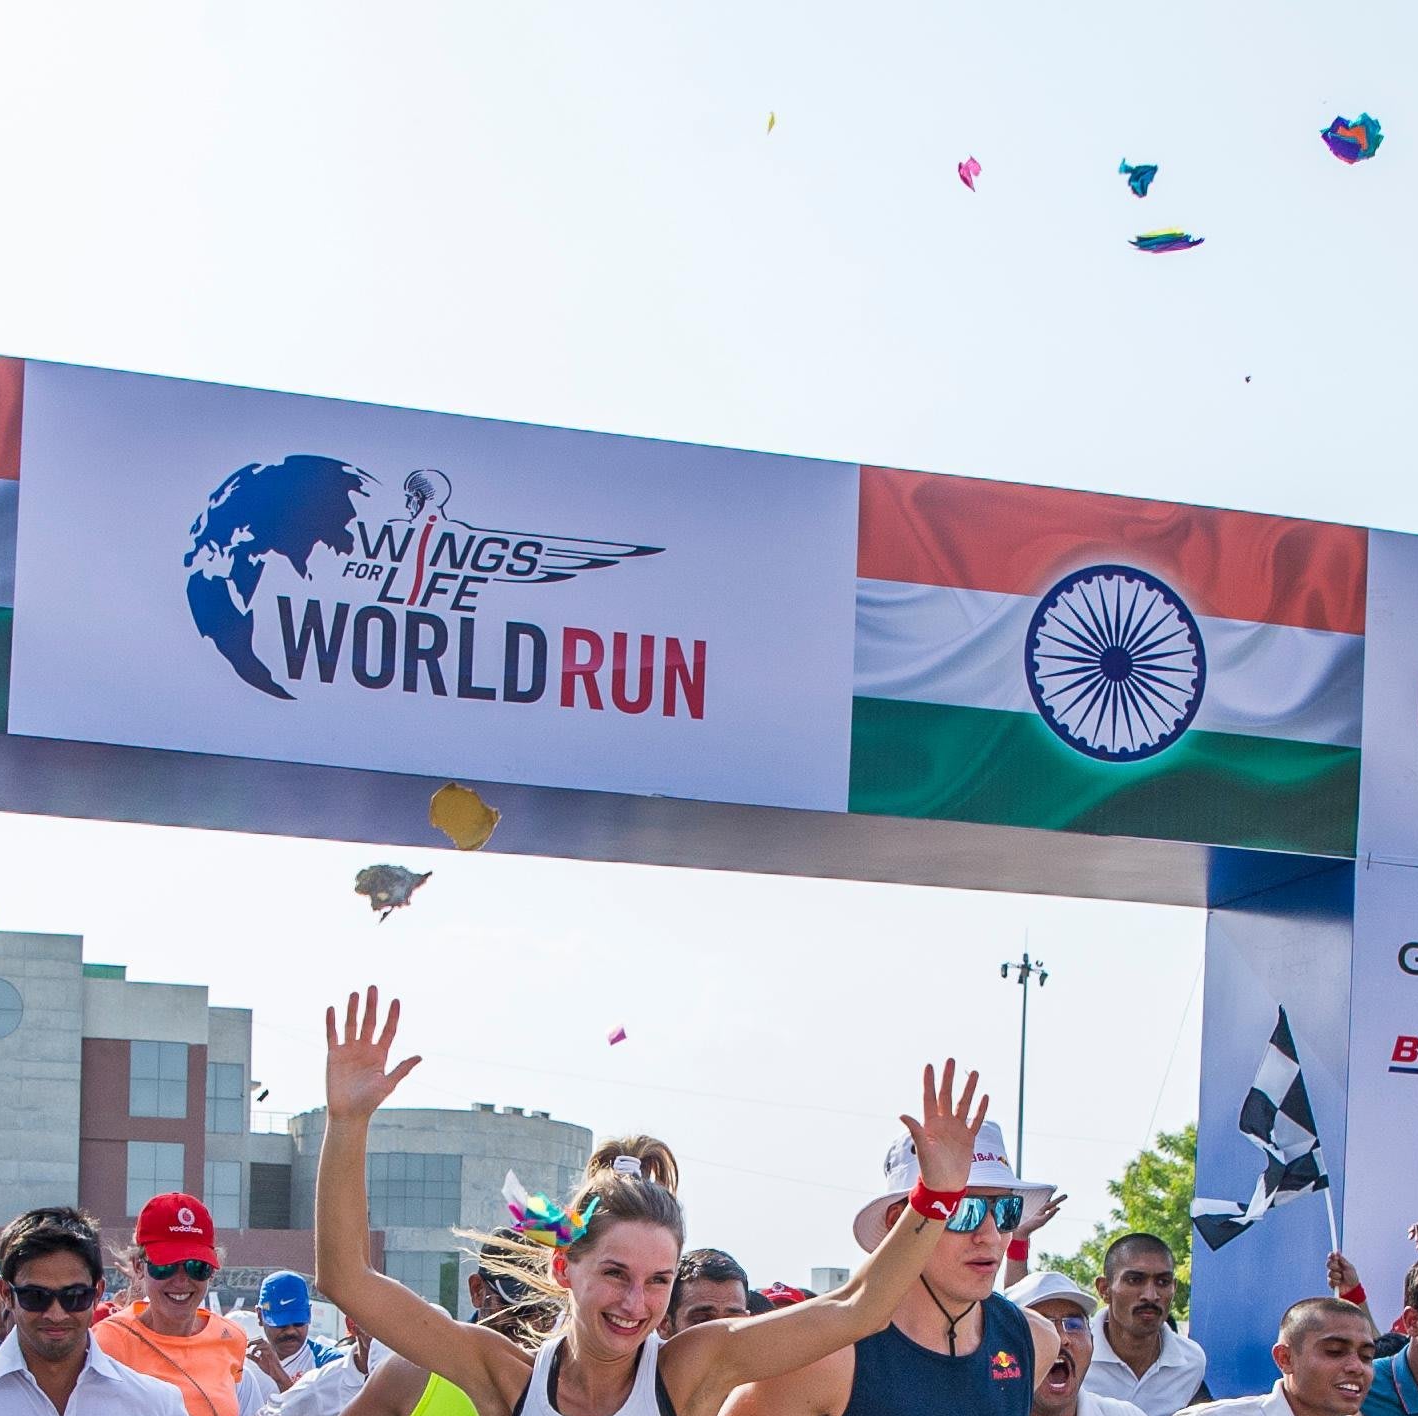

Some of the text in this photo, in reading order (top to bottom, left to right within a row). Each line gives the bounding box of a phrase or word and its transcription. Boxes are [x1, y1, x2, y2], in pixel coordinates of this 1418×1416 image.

[356, 515, 543, 577] WINGS
[342, 561, 488, 613] FOR LIFE
